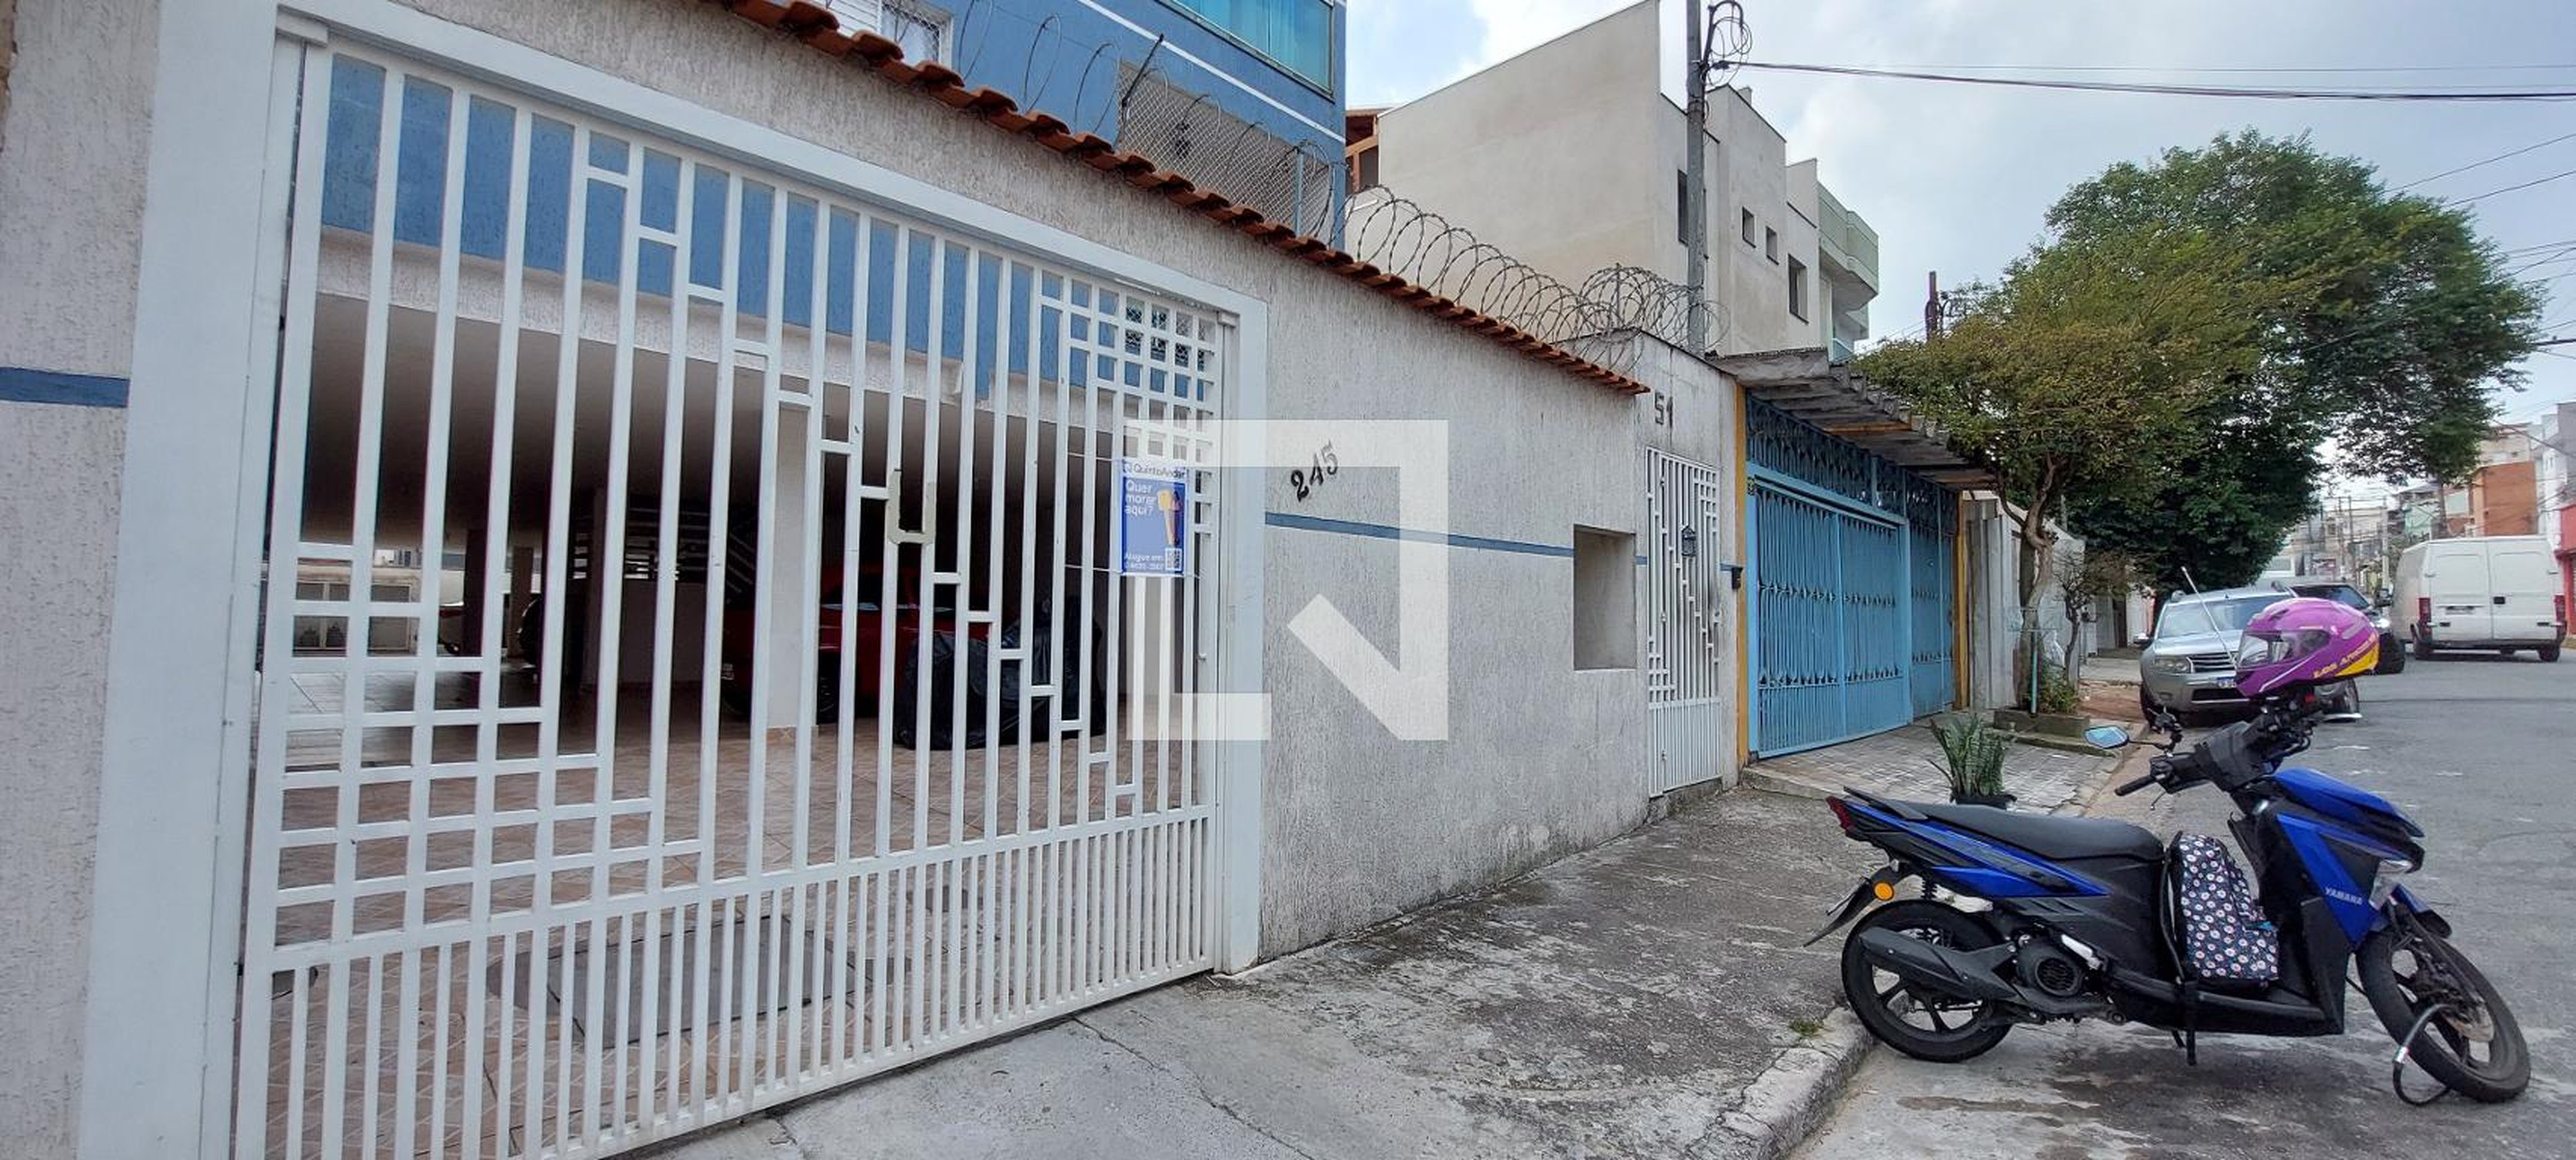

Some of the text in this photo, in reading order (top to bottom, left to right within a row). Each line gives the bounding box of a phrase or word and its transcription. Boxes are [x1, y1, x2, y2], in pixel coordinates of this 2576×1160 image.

[1654, 391, 1673, 429] 51
[1290, 440, 1338, 503] 245
[1126, 480, 1152, 493] Quer
[1126, 494, 1157, 504] morar
[1124, 505, 1154, 517] aqui?
[2325, 888, 2363, 905] YAMAHA
